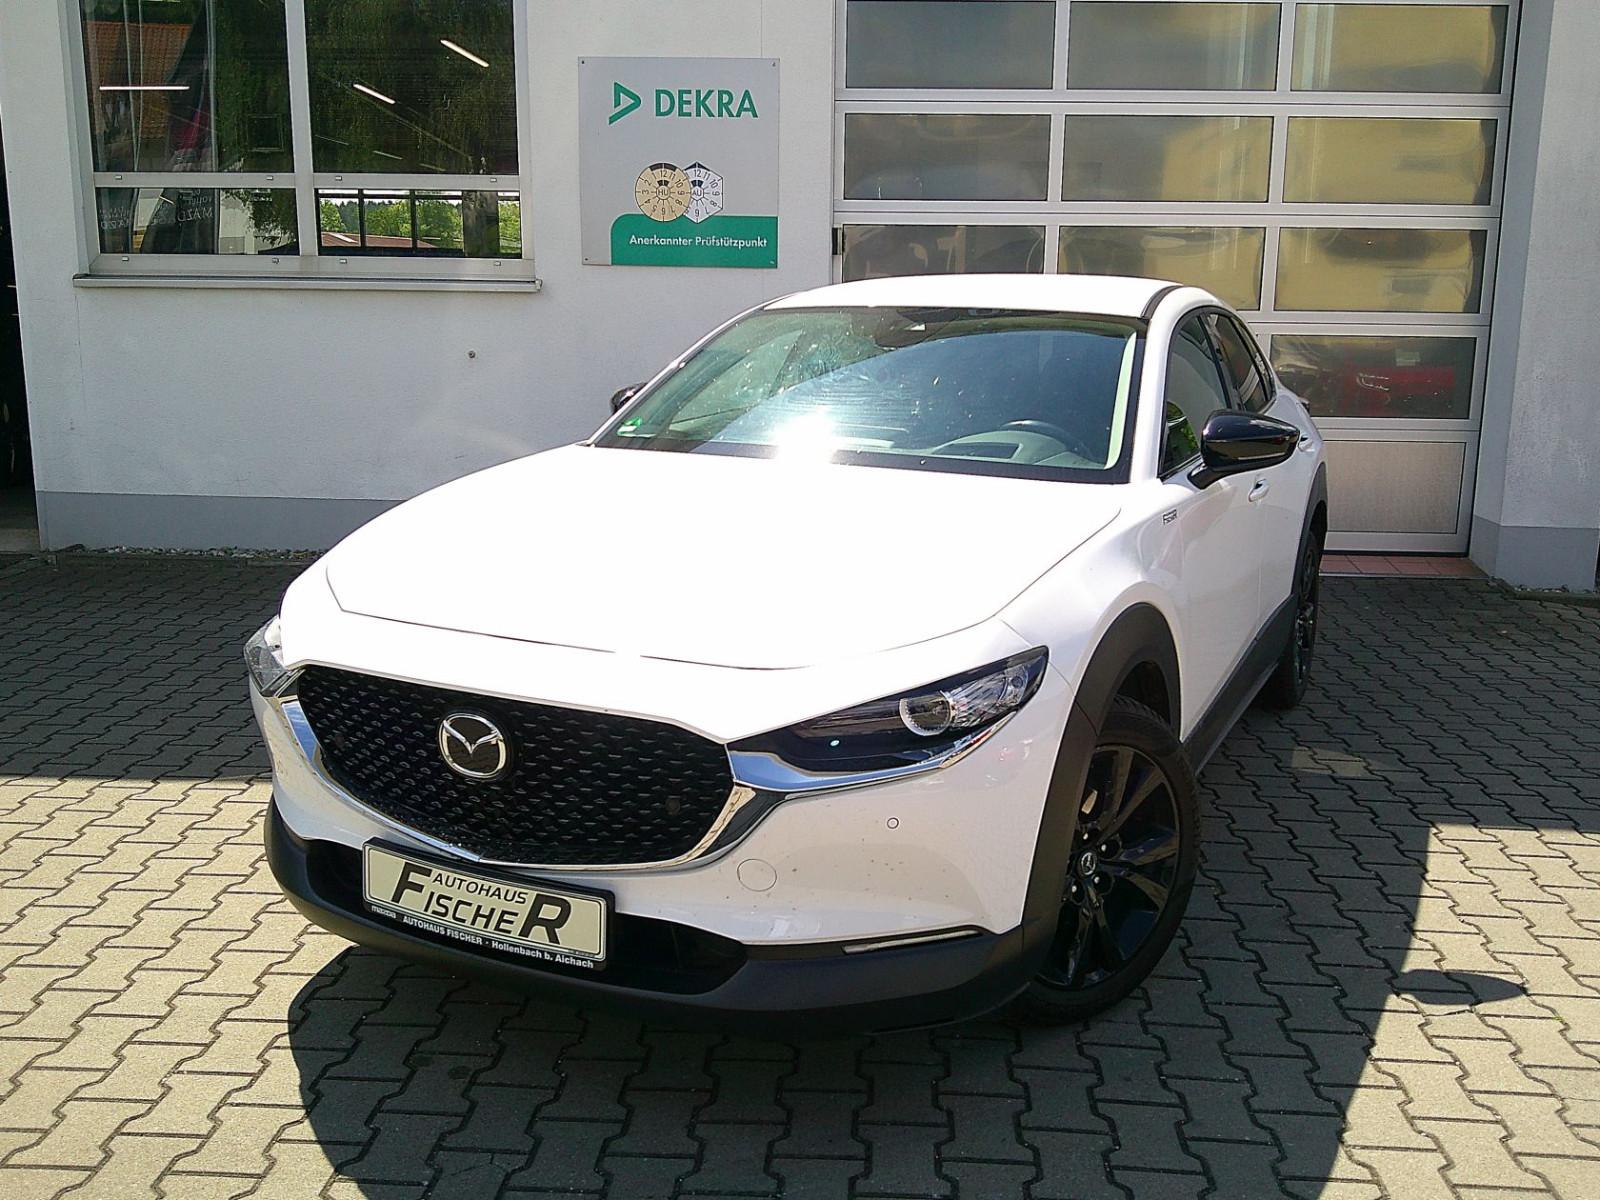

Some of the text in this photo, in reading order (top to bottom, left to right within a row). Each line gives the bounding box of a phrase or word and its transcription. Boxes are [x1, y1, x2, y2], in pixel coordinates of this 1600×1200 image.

[655, 89, 758, 118] DEKRA
[660, 169, 667, 177] 12
[669, 172, 676, 180] 11
[694, 169, 701, 177] 12
[704, 172, 711, 181] 11
[644, 179, 652, 187] 2
[674, 179, 683, 189] 10
[709, 179, 719, 189] 10
[657, 189, 669, 197] HU
[692, 189, 702, 197] AU
[629, 235, 768, 249] Anerkannter Prüfstützpunkt
[432, 873, 530, 905] AUTOHAUS
[391, 862, 571, 944] FISCHER
[402, 916, 445, 935] AUTOHAUS
[446, 929, 483, 945] FISCHER
[491, 940, 542, 959] Hollenbach
[555, 954, 594, 969] Aichach
